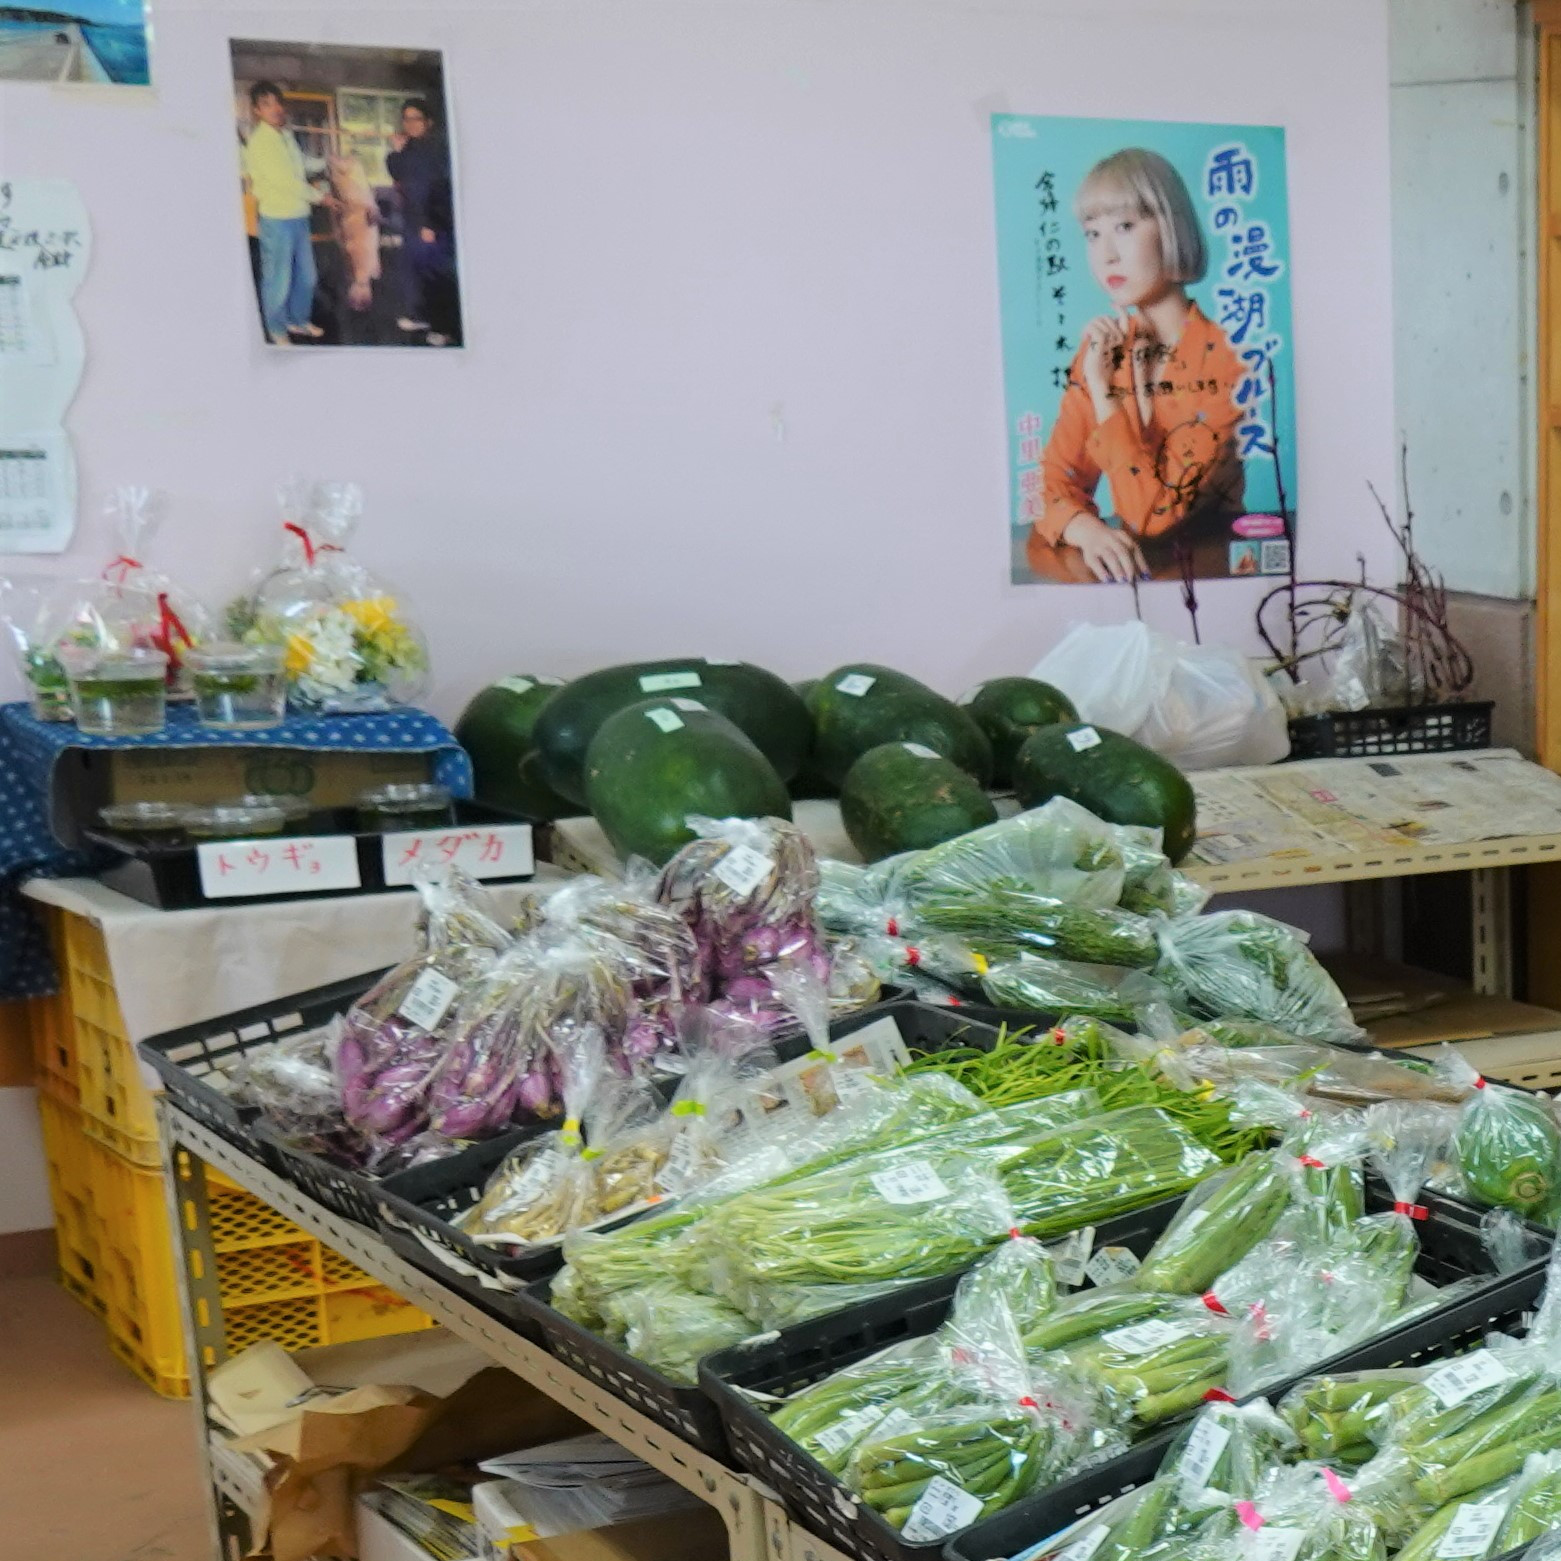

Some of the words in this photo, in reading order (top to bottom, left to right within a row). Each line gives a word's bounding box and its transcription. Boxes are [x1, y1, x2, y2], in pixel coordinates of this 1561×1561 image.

[1205, 147, 1282, 456] 雨の漫湖ブルース
[214, 843, 322, 876] トウギョ
[397, 831, 506, 867] メダカ
